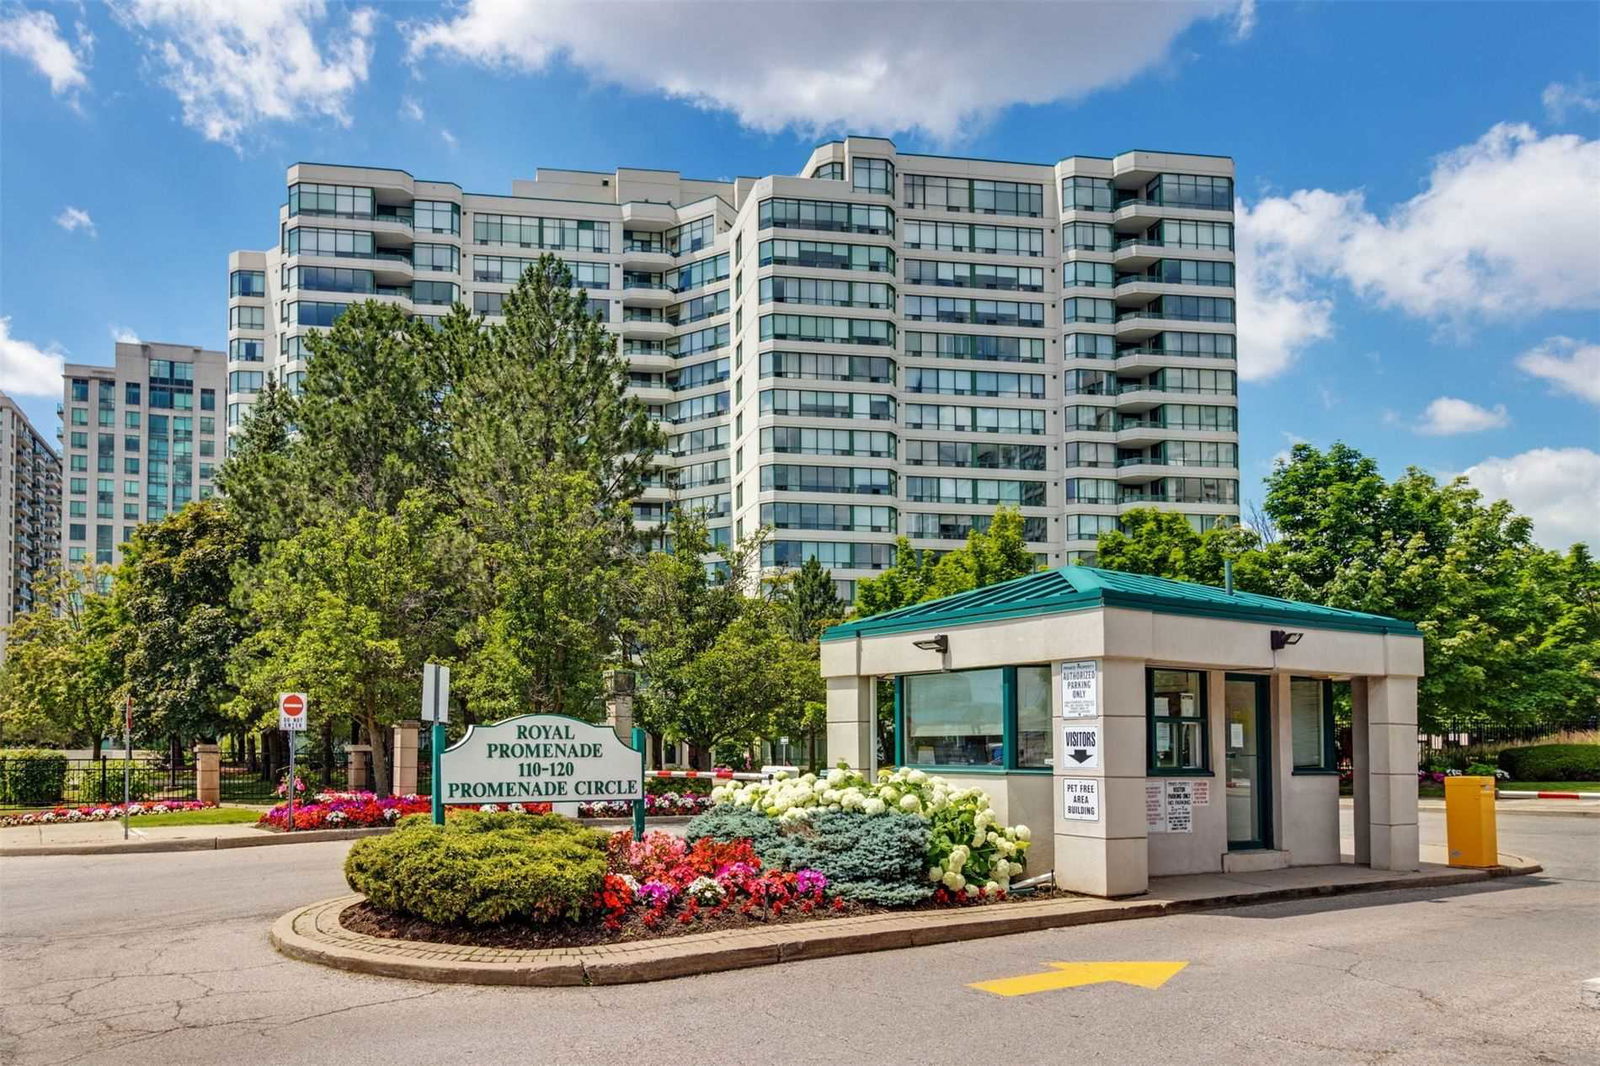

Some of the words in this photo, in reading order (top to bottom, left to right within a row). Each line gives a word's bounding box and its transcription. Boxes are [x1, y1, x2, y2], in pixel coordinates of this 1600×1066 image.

[1063, 671, 1095, 680] AUTHORIZED
[1067, 681, 1091, 689] PARKING
[1072, 690, 1086, 698] ONLY
[516, 725, 576, 740] ROYAL
[1065, 731, 1096, 747] VISITORS
[486, 743, 603, 759] PROMENADE
[518, 762, 574, 777] 110-120
[448, 781, 568, 798] PROMENADE
[574, 780, 638, 796] CIRCLE
[1067, 784, 1078, 792] PET
[1079, 784, 1095, 793] FREE
[1073, 795, 1089, 804] AREA
[1067, 805, 1095, 815] BUILDING
